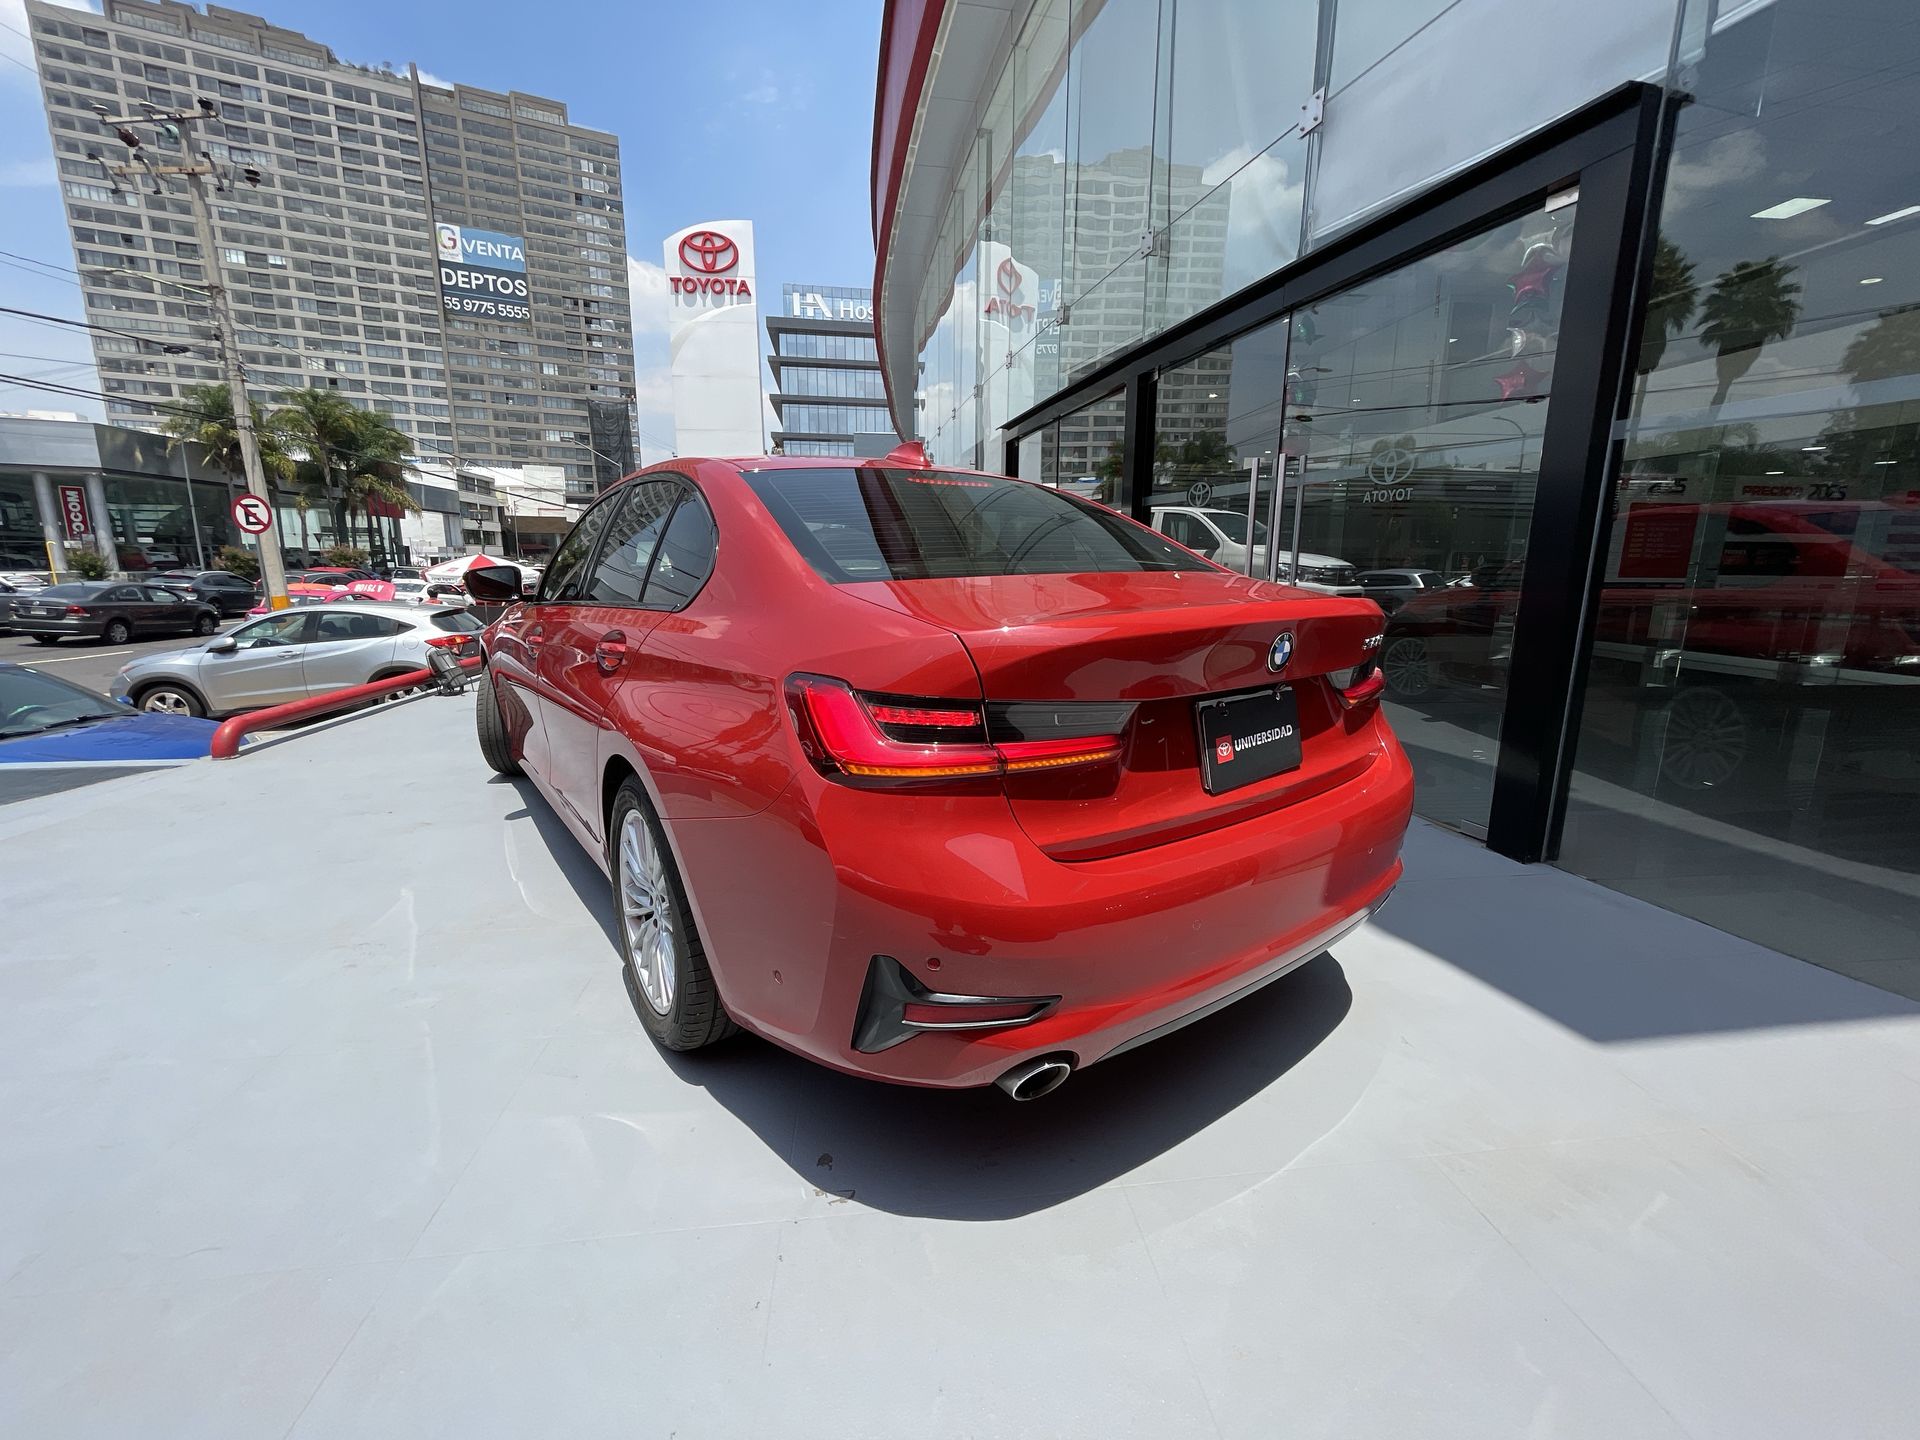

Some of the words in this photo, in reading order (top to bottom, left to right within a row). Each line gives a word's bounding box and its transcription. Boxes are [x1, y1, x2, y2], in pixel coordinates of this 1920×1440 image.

[462, 238, 525, 262] VENTA
[440, 267, 528, 297] DEPTOS
[669, 277, 751, 296] TOYOTA
[443, 296, 461, 311] 55
[463, 299, 496, 315] 9775
[498, 303, 530, 319] 5555
[1234, 724, 1293, 752] UNIVERSIDAD
